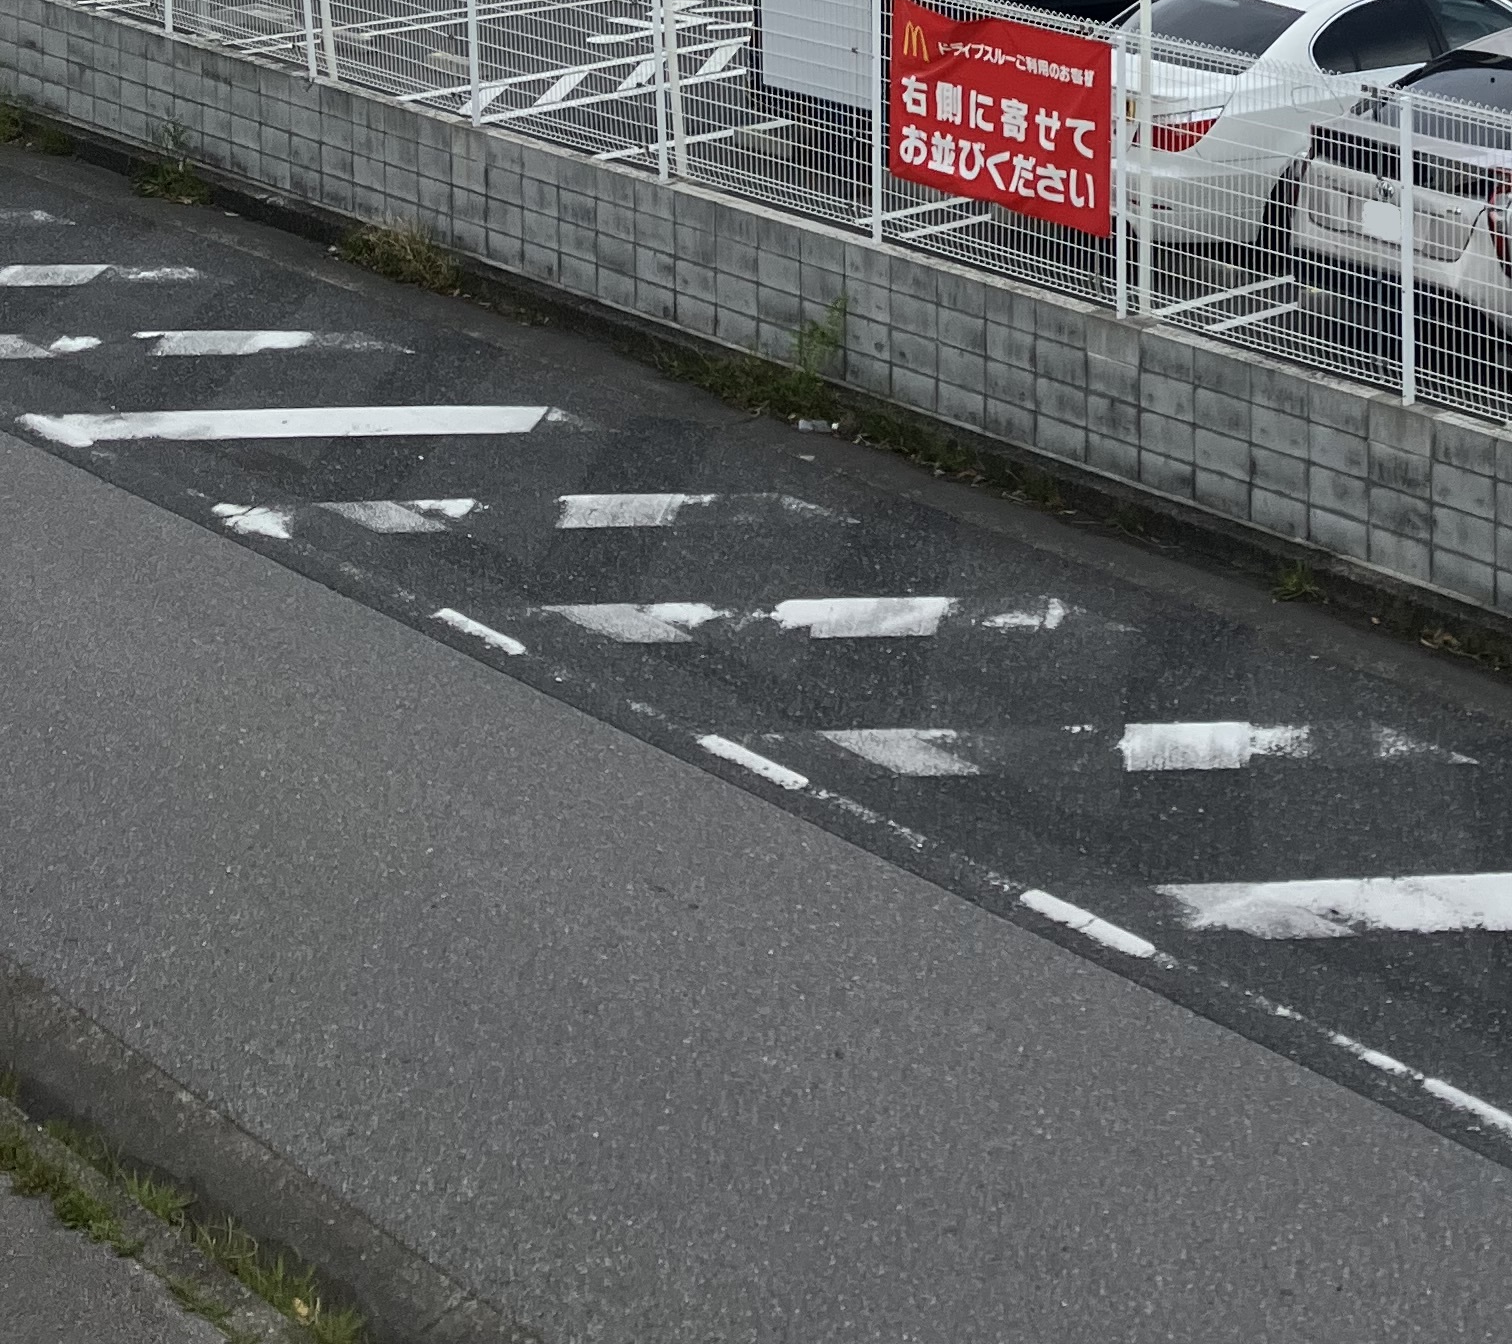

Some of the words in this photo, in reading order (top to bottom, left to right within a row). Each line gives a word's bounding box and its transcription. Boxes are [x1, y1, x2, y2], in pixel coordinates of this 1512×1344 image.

[901, 75, 1096, 159] 右側に寄せて
[899, 124, 1095, 209] お並びください
